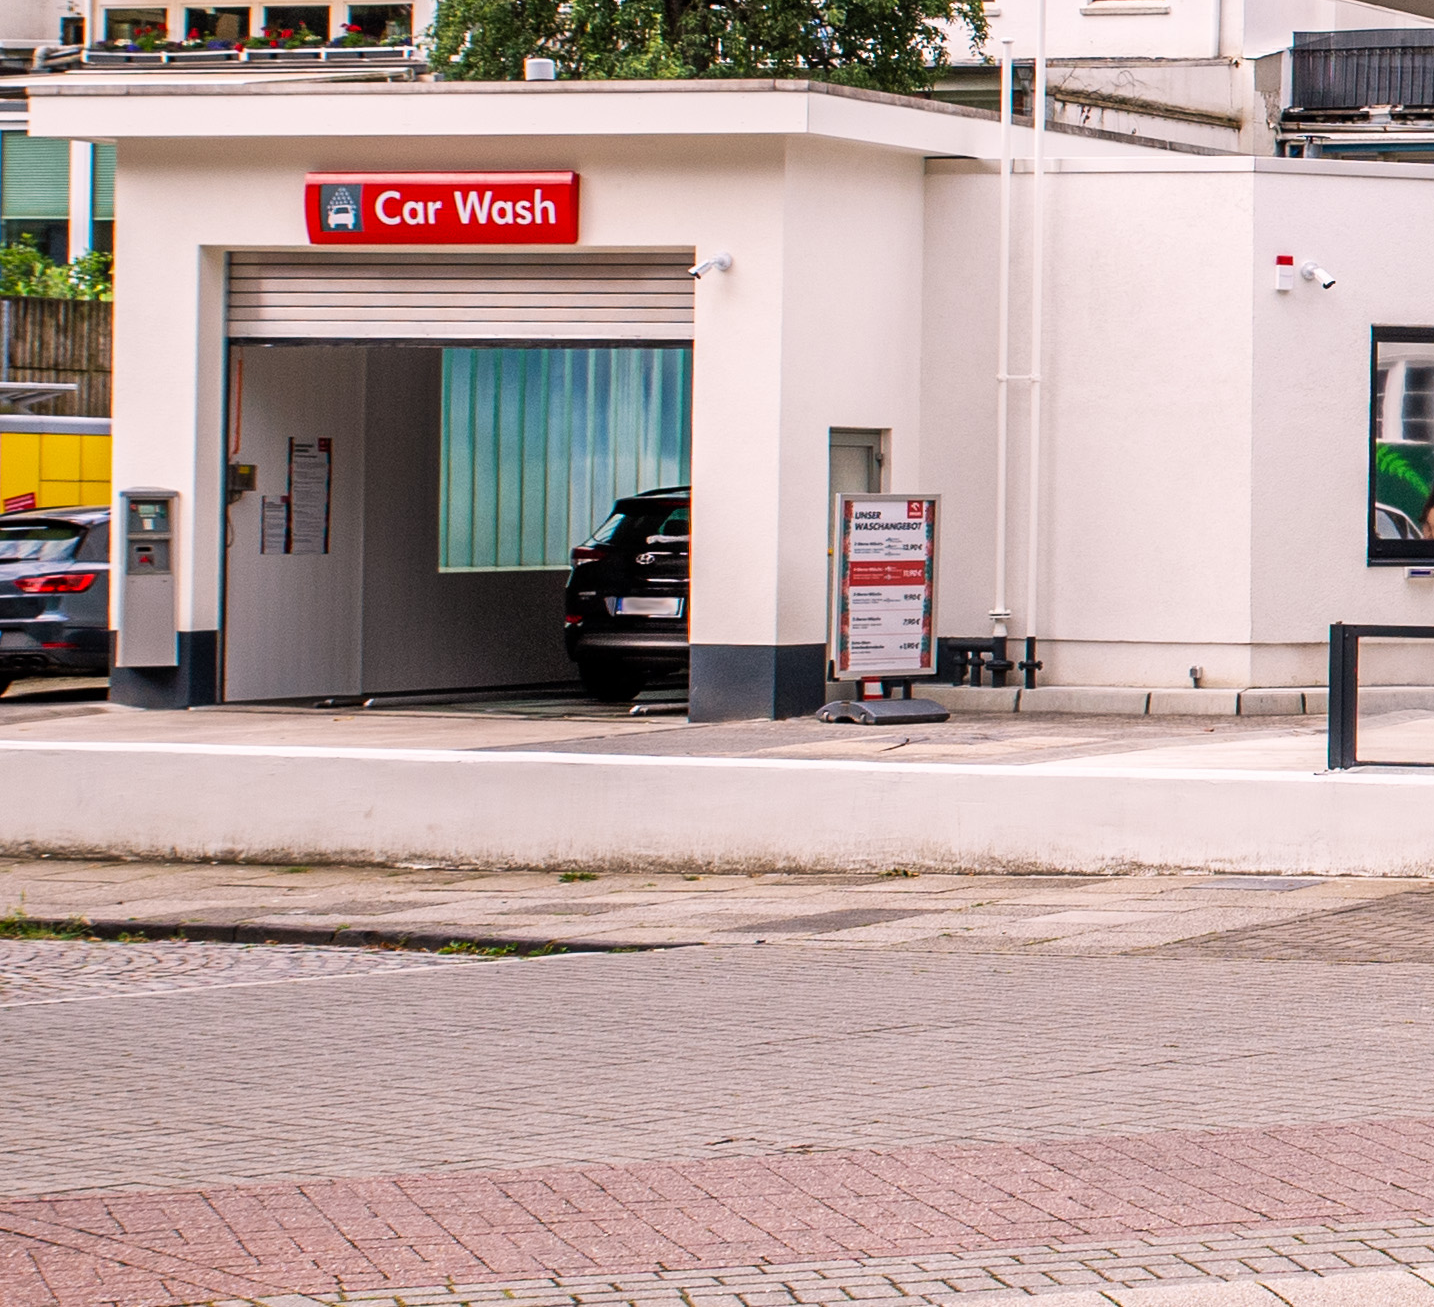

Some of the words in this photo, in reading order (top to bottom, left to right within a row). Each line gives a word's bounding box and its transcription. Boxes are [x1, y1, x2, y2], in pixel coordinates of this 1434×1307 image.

[375, 190, 443, 226] Car
[453, 188, 557, 226] Wash
[855, 511, 881, 519] UNSER
[855, 522, 922, 531] WASCHANGEBOT
